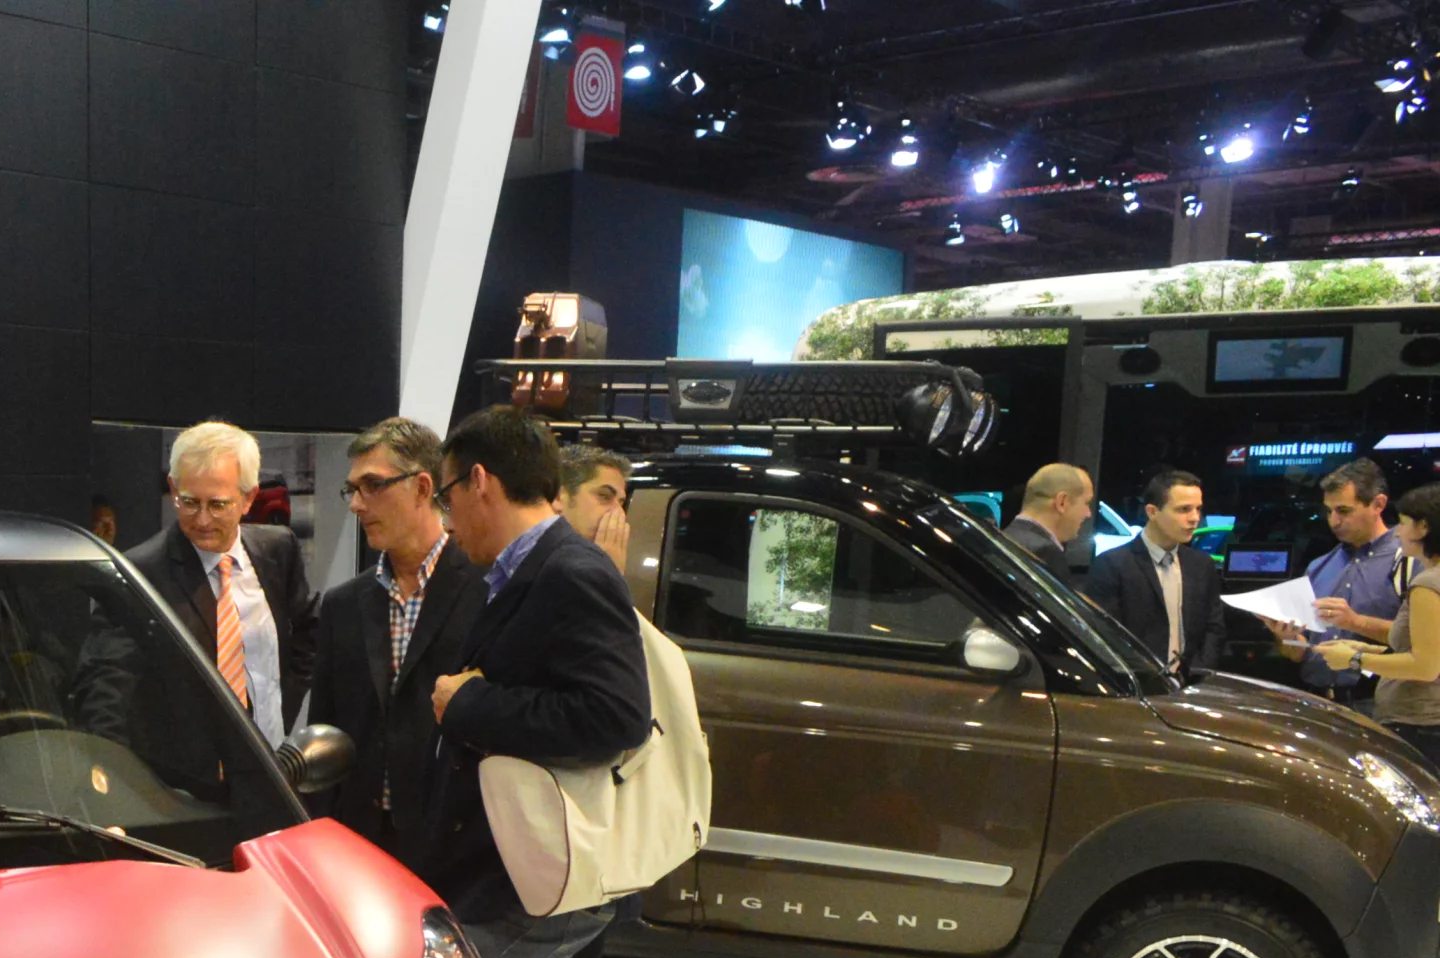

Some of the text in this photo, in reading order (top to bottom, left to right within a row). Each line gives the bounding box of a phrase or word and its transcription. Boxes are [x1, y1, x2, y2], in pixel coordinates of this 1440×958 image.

[1249, 441, 1354, 456] FIABILITÉ ÉPROUVÉE
[680, 889, 958, 931] HIGHLAND
